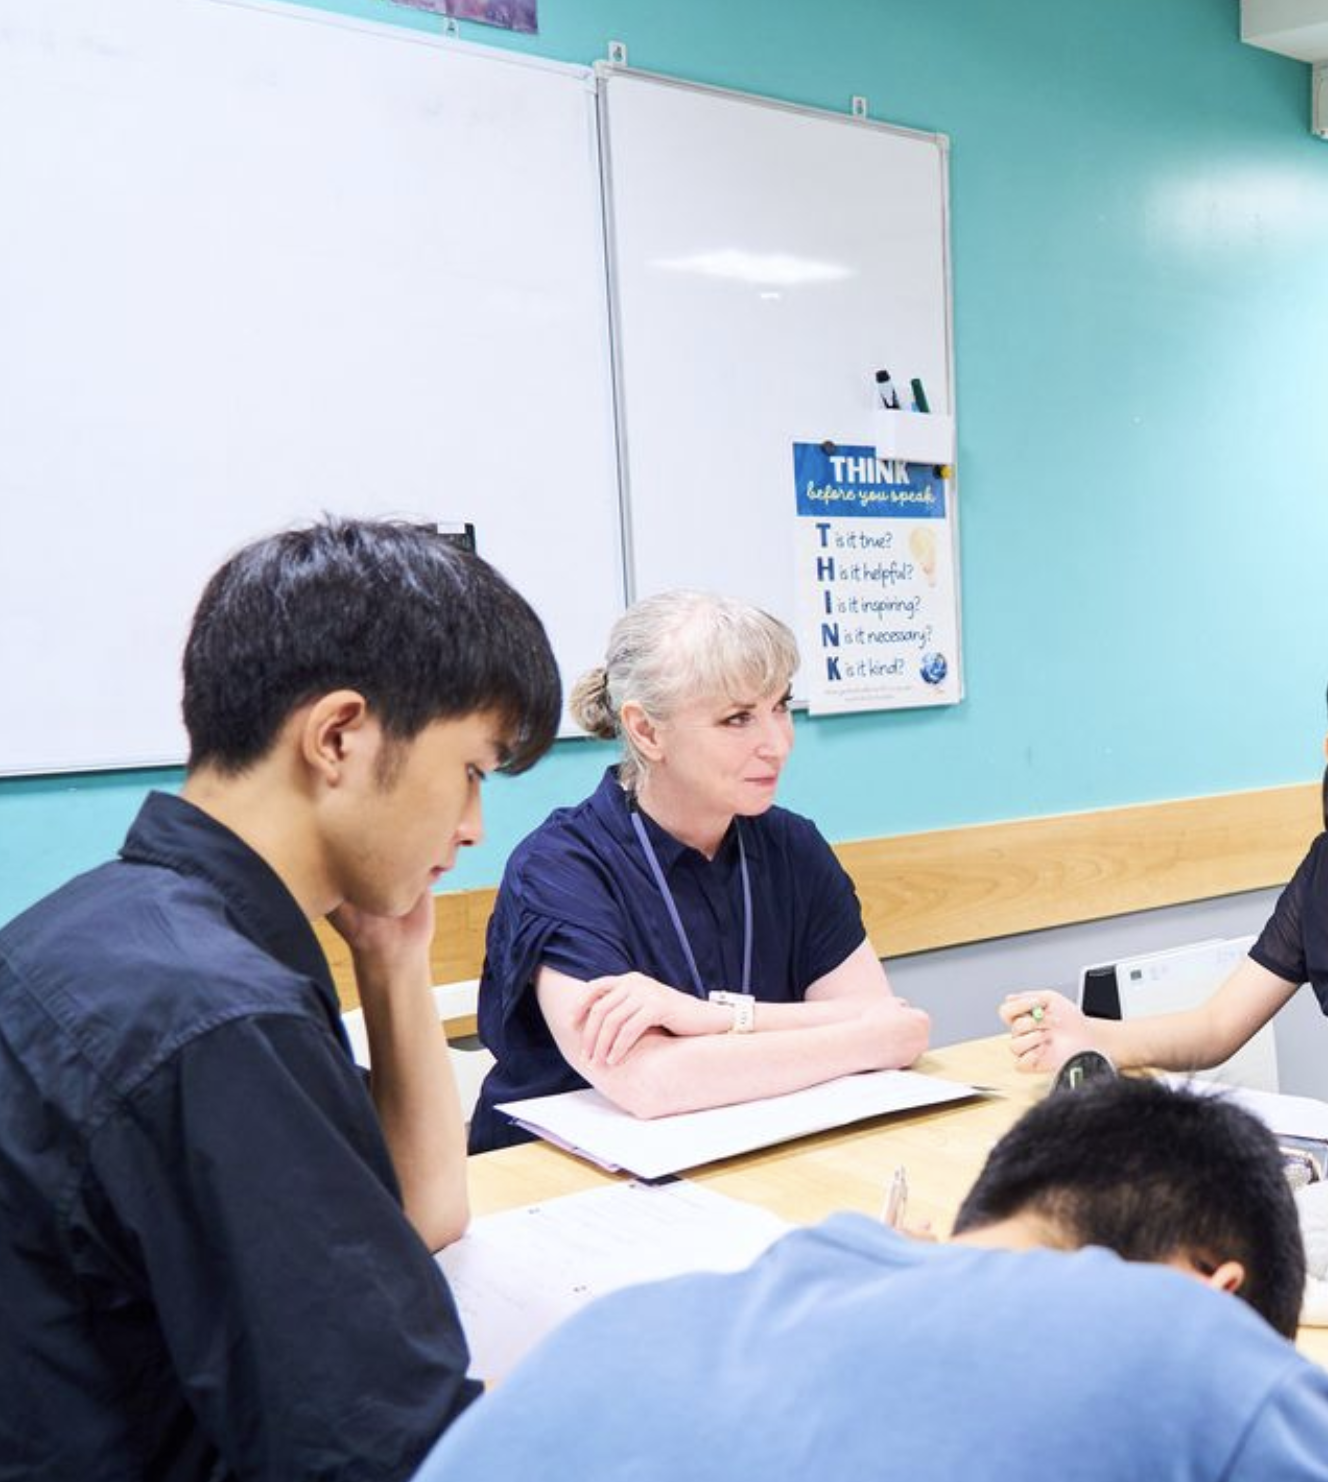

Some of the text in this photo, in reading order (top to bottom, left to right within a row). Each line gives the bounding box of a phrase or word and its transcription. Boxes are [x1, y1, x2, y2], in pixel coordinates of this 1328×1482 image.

[829, 456, 911, 485] THINK
[806, 480, 936, 507] before you speak
[815, 522, 893, 549] T is it true?
[817, 556, 914, 588] H is it helpful?
[825, 590, 921, 620] I is it inspiring?
[821, 622, 933, 650] N is it necessary?
[827, 656, 905, 681] K is it kind?
